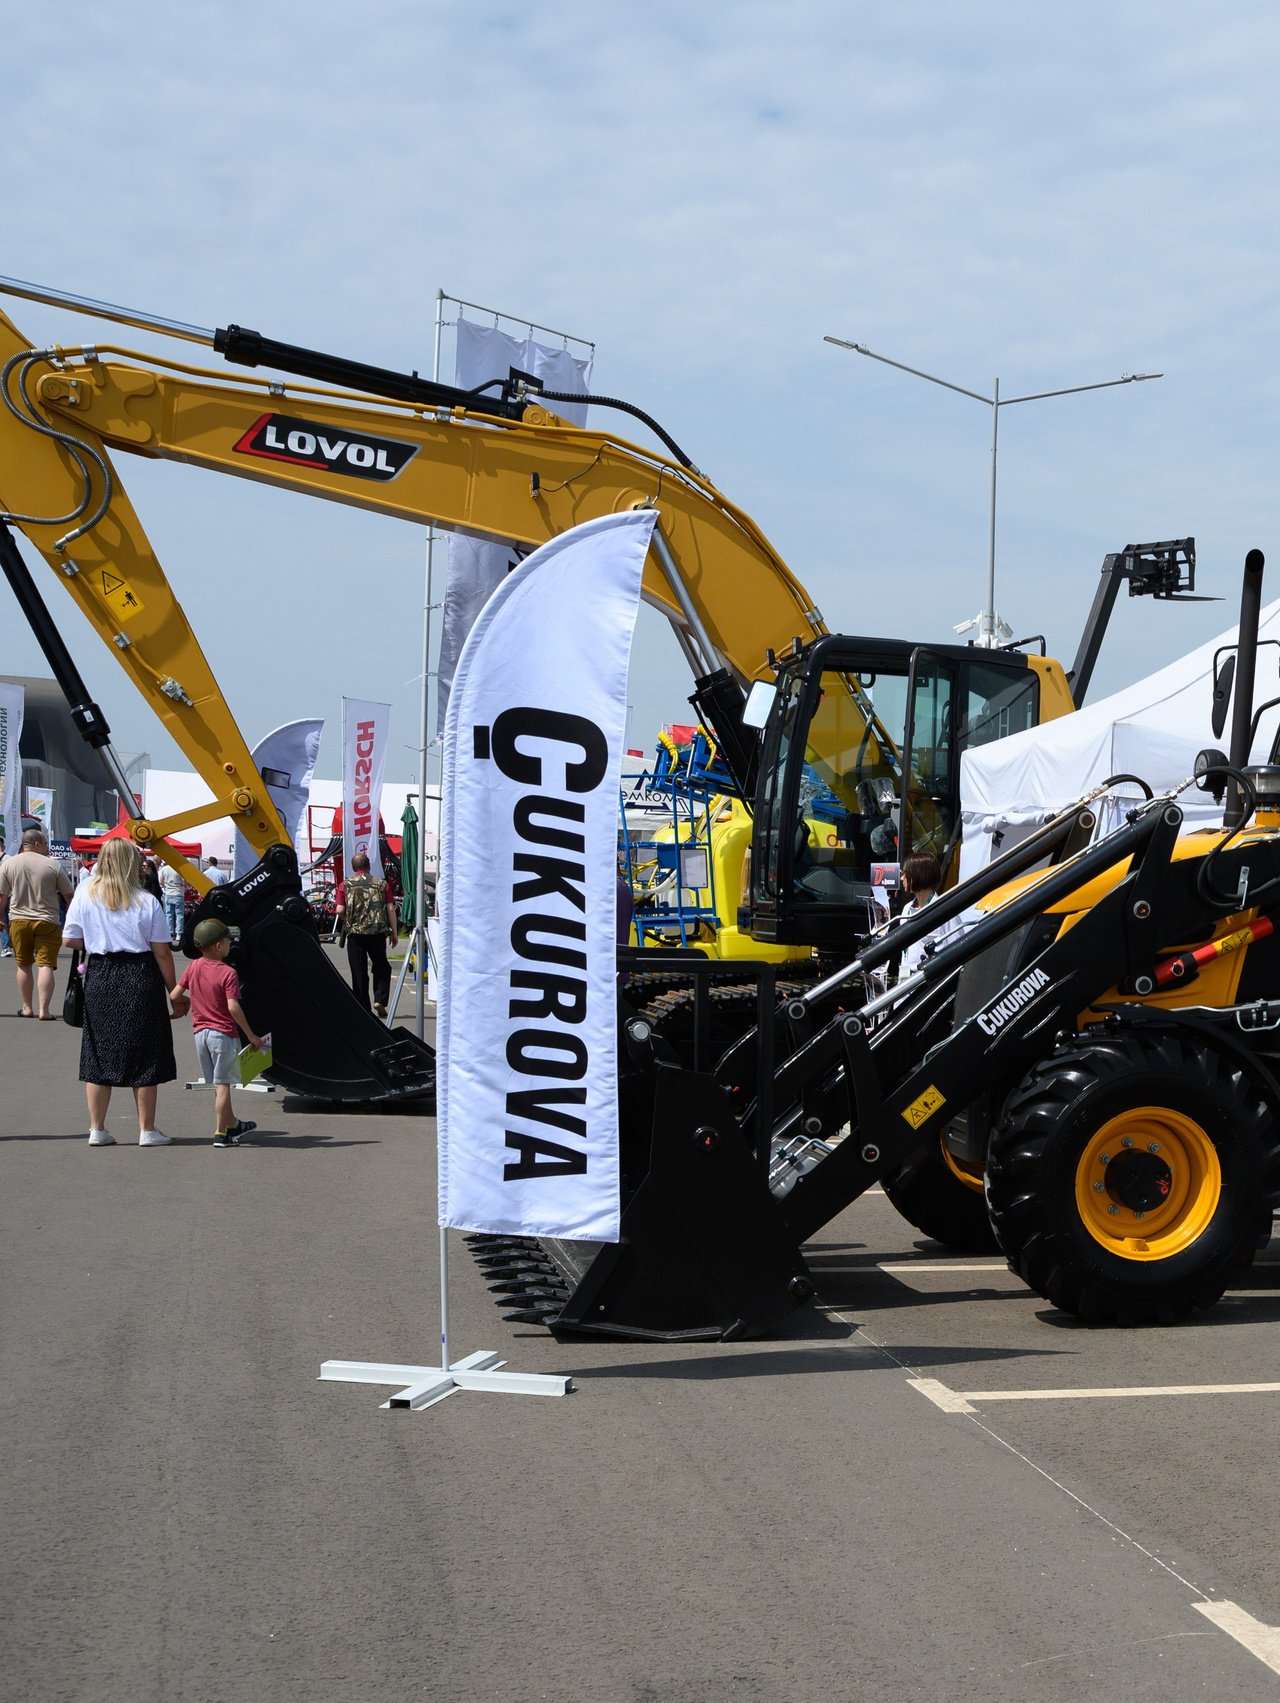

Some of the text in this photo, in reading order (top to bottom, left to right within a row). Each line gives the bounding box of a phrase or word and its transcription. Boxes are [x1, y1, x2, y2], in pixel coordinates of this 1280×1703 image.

[265, 425, 396, 473] LOVOL
[238, 871, 271, 896] LOVOL
[473, 706, 608, 1182] ÇUKUROVA
[976, 967, 1051, 1036] ÇUKUROVA
